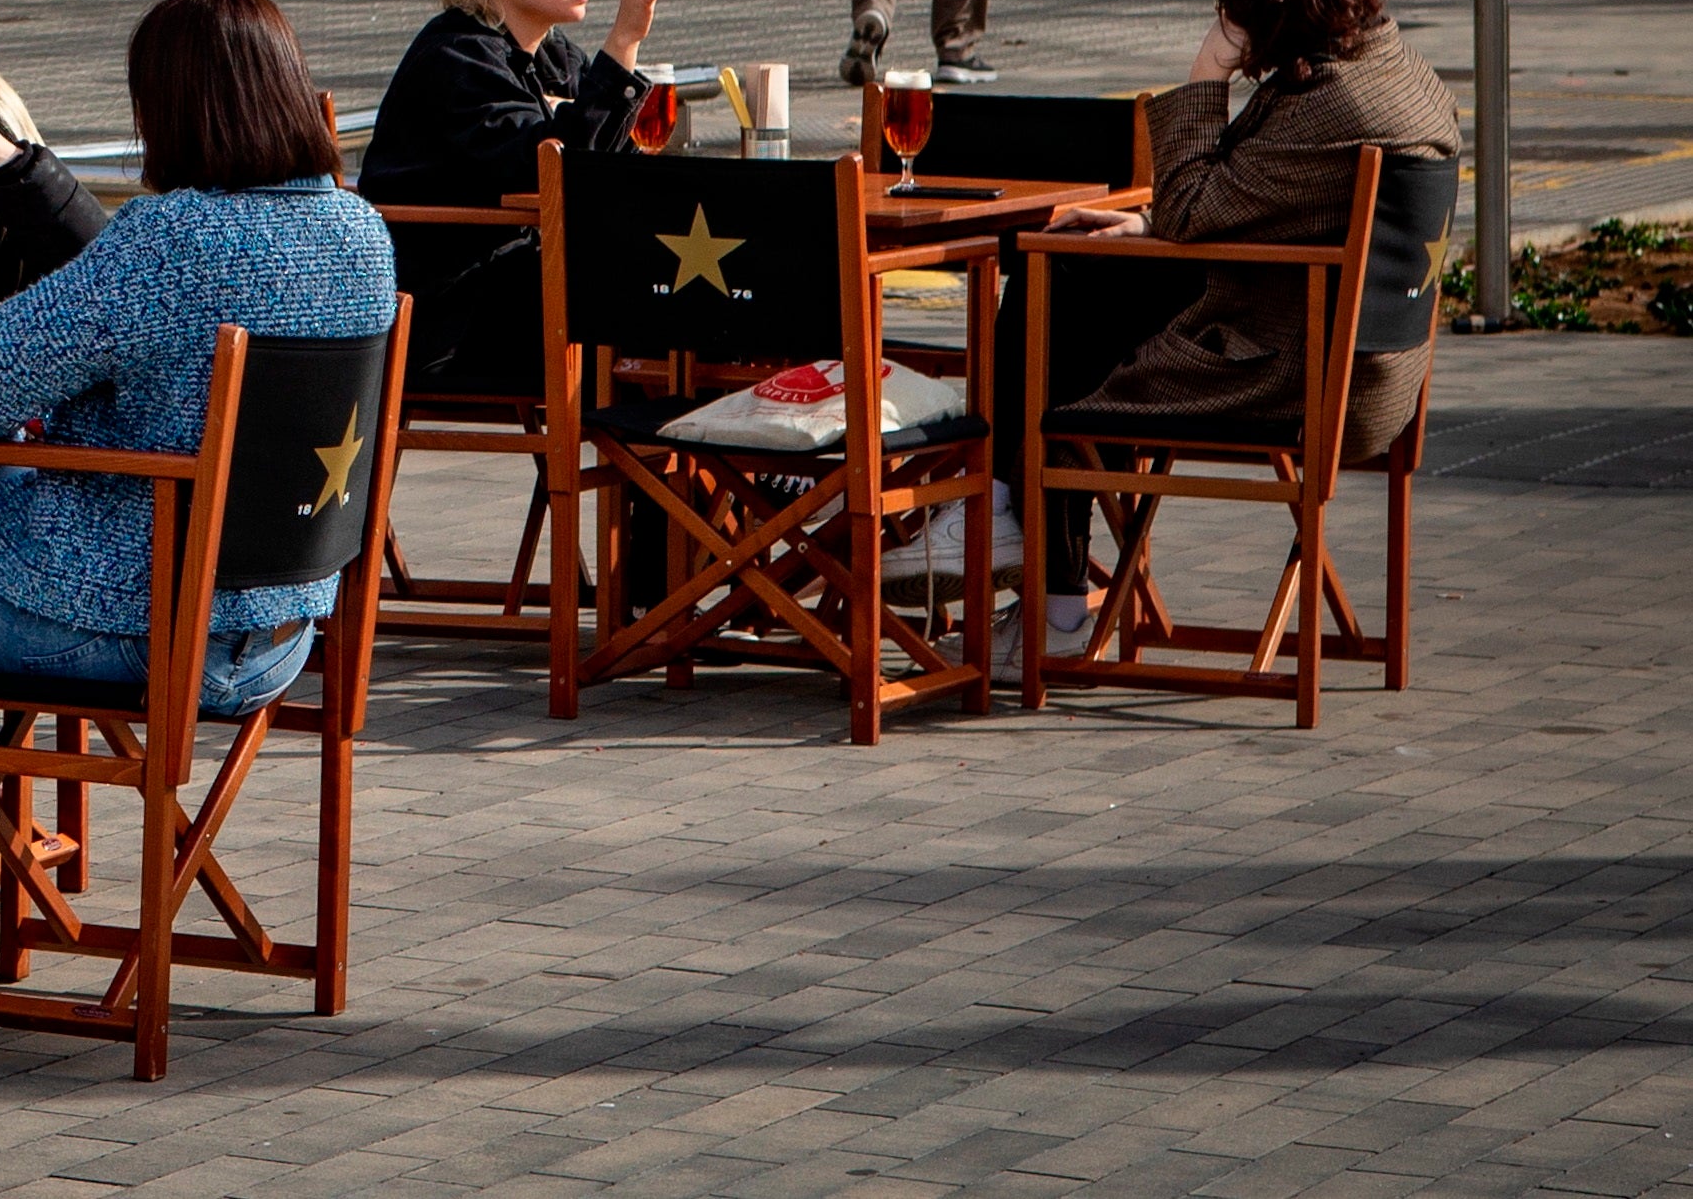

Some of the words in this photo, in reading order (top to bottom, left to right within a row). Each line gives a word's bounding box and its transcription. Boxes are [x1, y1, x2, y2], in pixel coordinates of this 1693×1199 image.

[652, 283, 670, 295] 18
[731, 288, 753, 300] 76
[297, 503, 312, 516] 18
